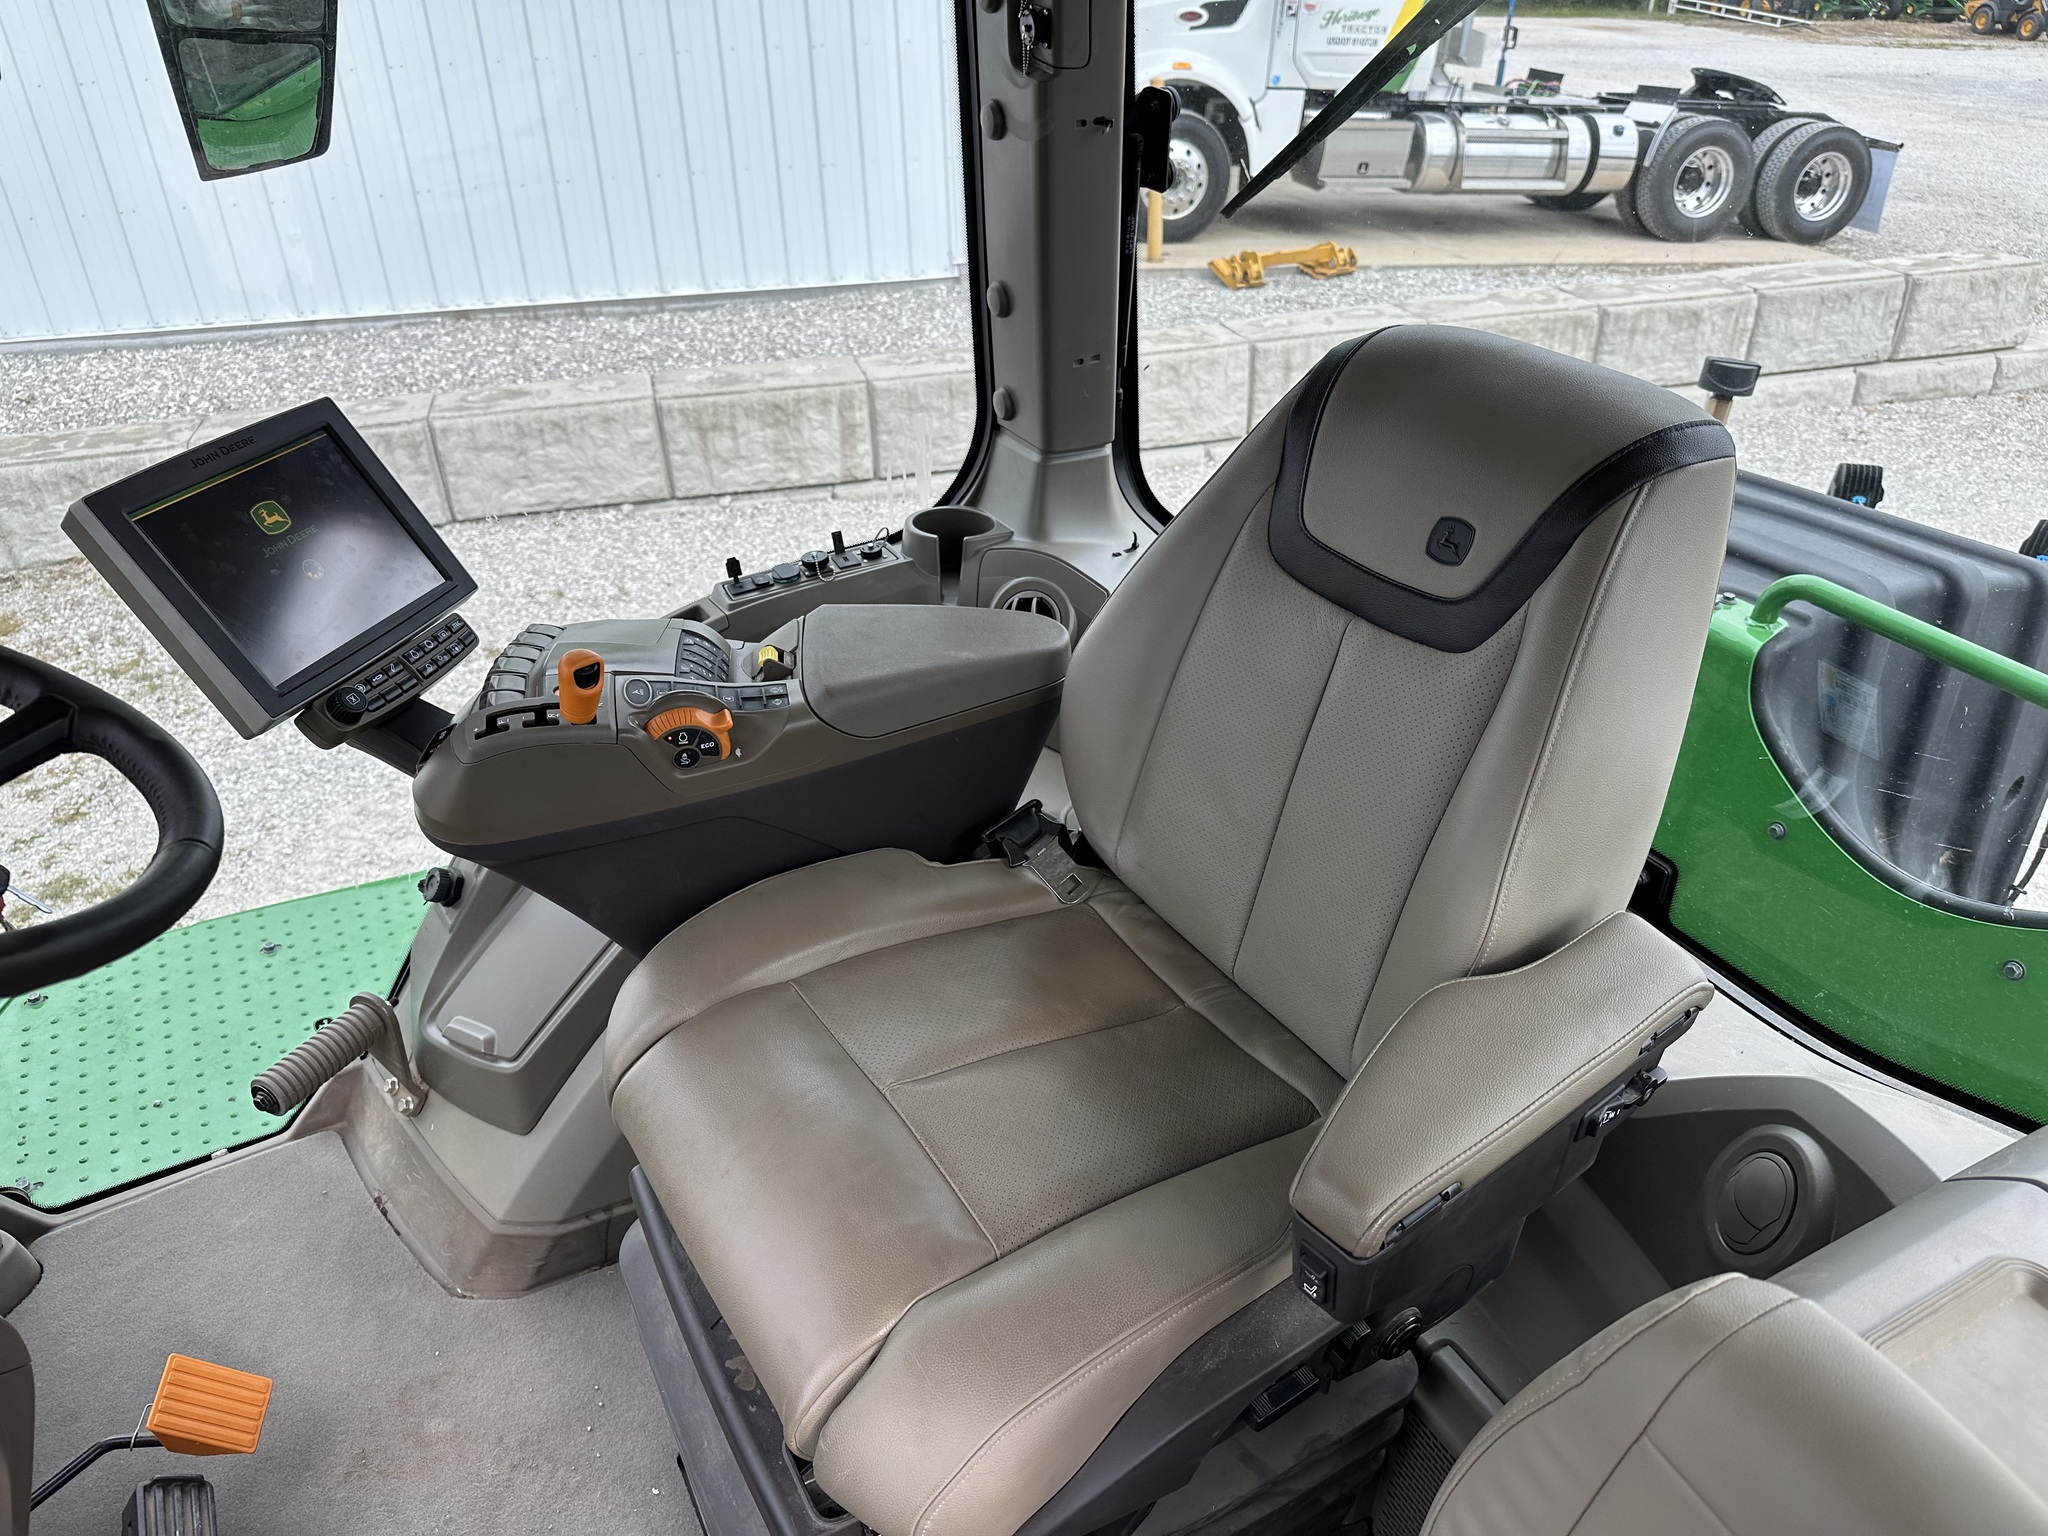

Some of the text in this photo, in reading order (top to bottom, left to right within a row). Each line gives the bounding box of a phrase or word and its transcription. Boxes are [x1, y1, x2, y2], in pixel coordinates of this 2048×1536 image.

[1341, 24, 1388, 34] TRACTOR
[190, 435, 257, 470] JOHN DEERE
[262, 524, 318, 558] JOHN DEERE
[700, 741, 715, 749] ECO
